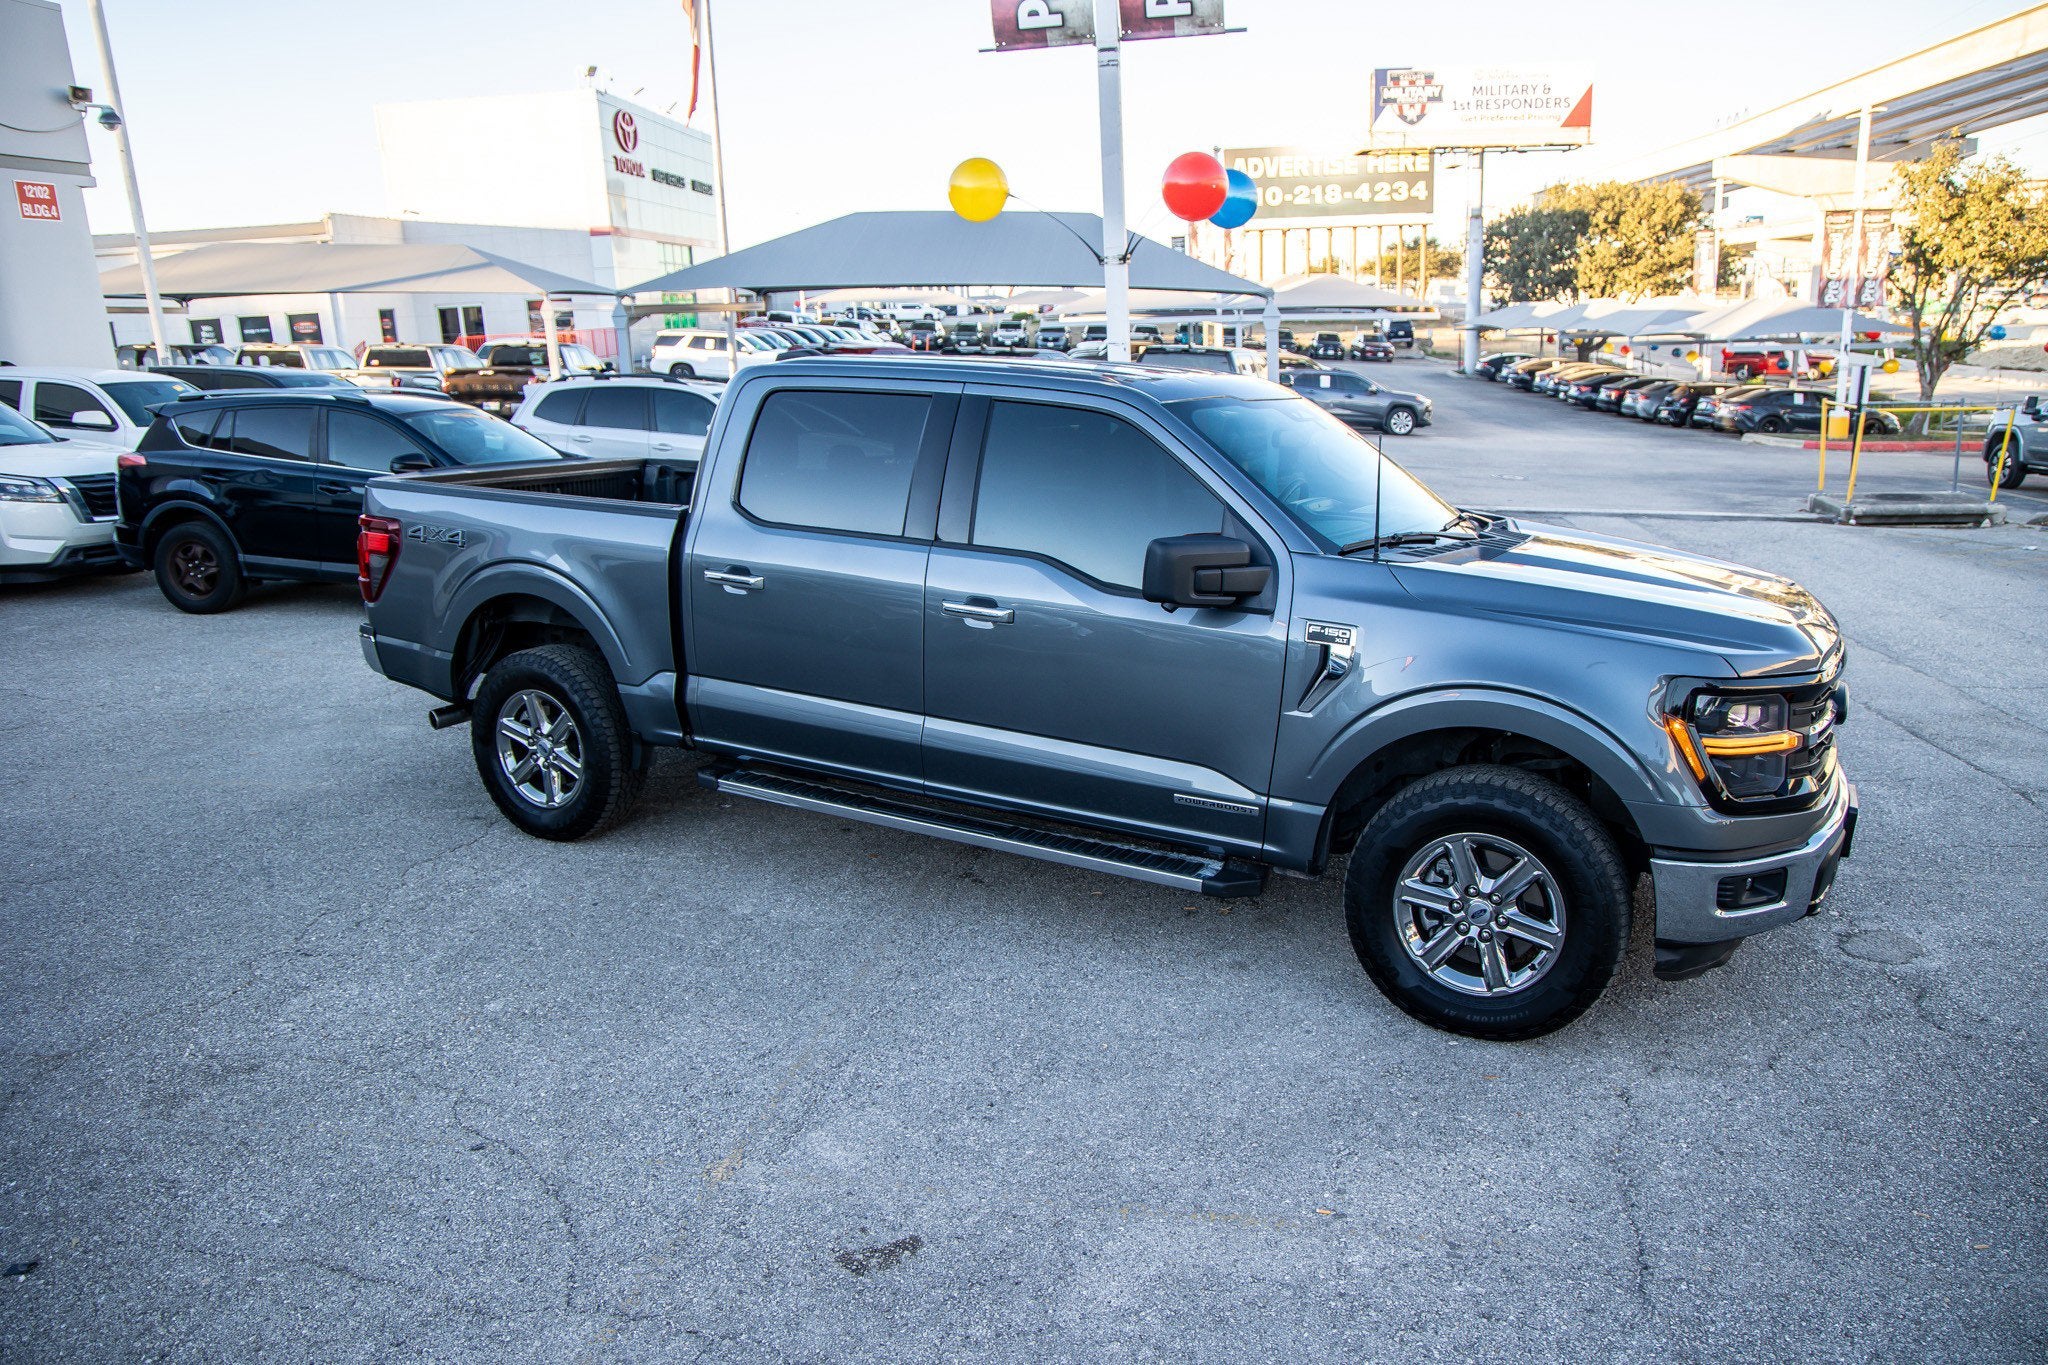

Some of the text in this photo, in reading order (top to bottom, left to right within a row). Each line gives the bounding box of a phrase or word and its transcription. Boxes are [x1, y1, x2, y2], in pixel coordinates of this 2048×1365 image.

[1472, 84, 1552, 96] MILITARY &
[1453, 97, 1571, 110] 1st RESPONDERS
[613, 155, 645, 178] TOYOTA
[1233, 154, 1430, 178] ADVERTISE HERE
[22, 184, 51, 200] 12102
[1256, 181, 1428, 207] 10-218-4234
[1308, 625, 1350, 638] F-150
[1177, 797, 1254, 814] POWERBOOST
